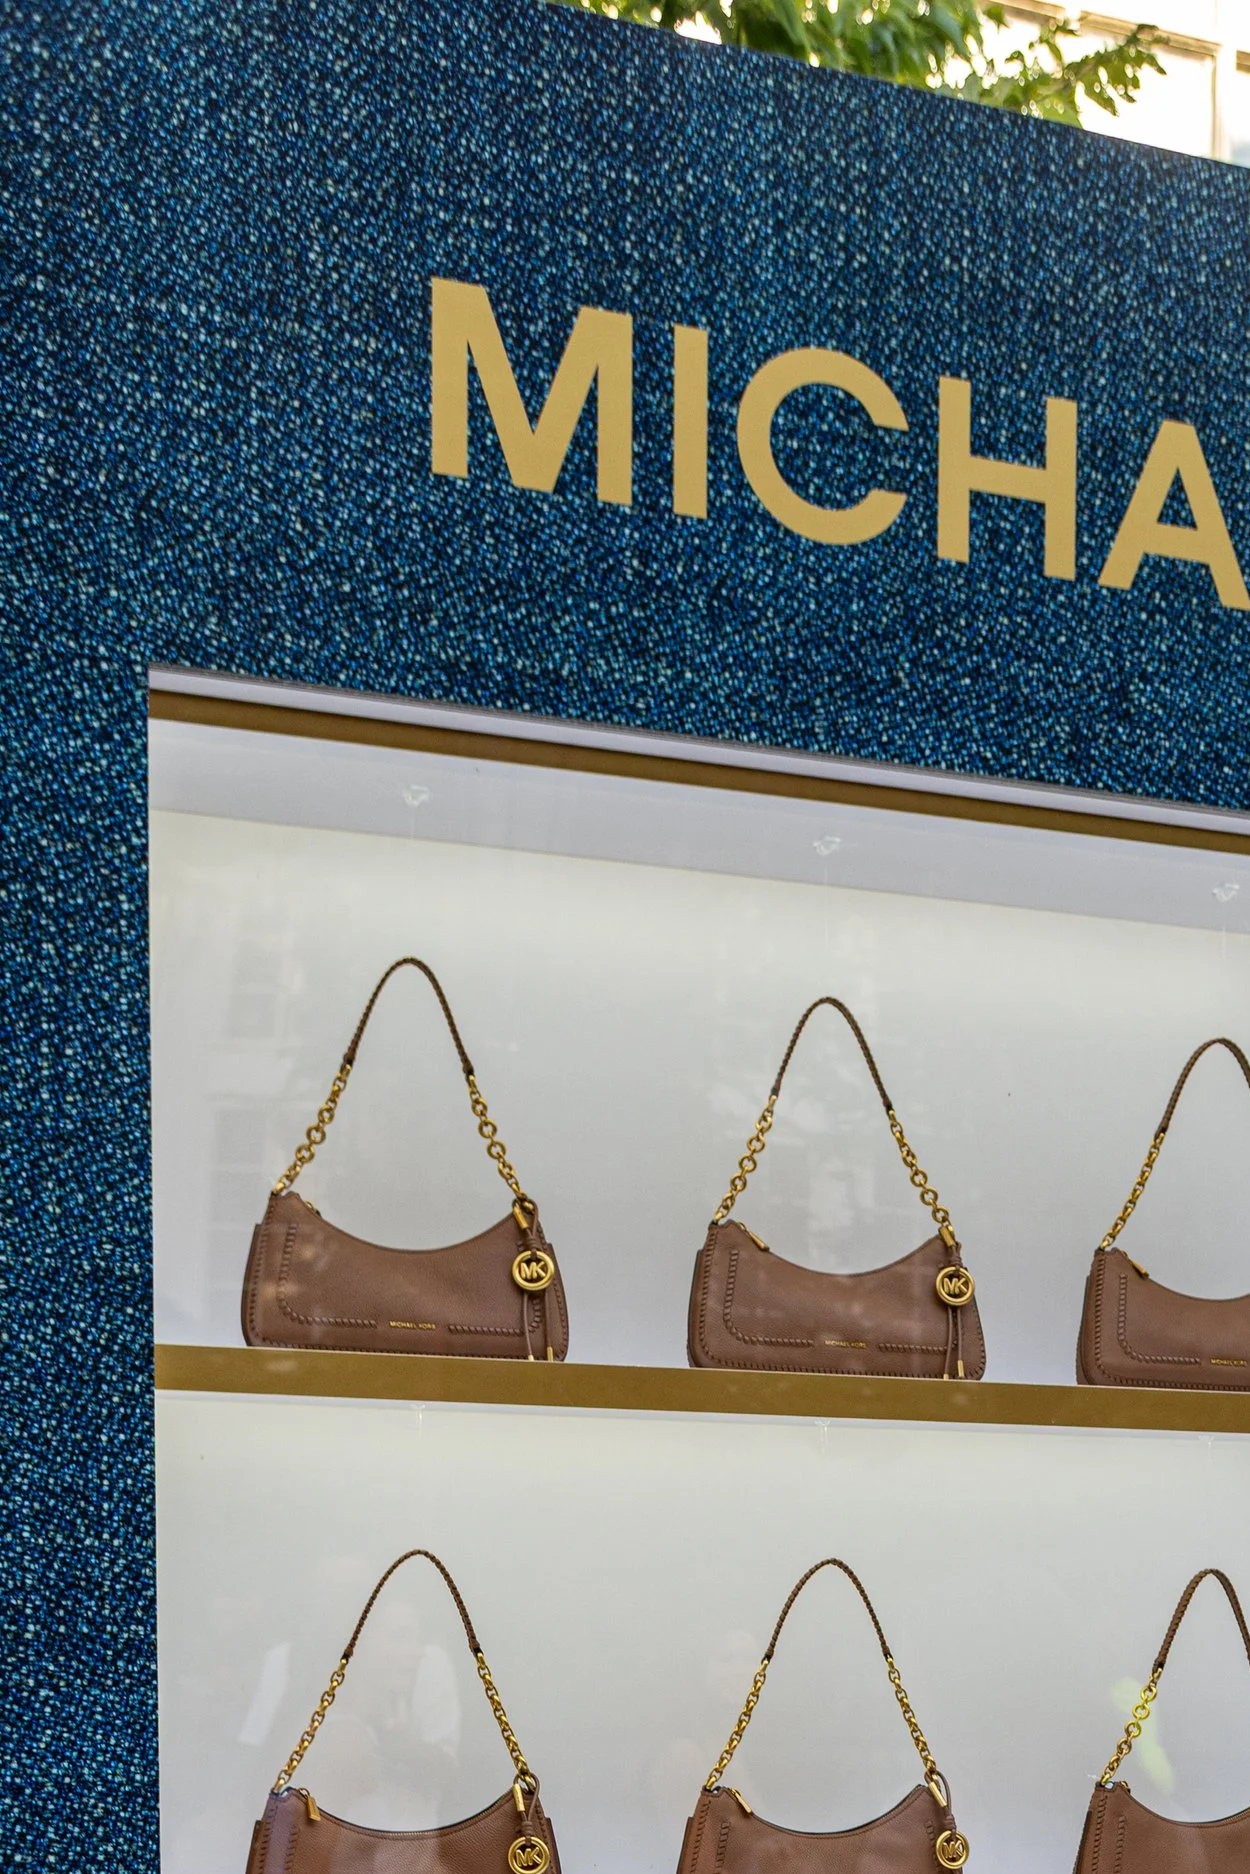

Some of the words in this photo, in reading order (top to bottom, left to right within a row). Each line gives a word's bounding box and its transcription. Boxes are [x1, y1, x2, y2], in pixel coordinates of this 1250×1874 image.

[519, 1260, 546, 1280] MK
[943, 1274, 968, 1296] MK
[390, 1320, 417, 1330] MICHAEL
[516, 1846, 542, 1867] MK
[943, 1839, 965, 1859] MK
